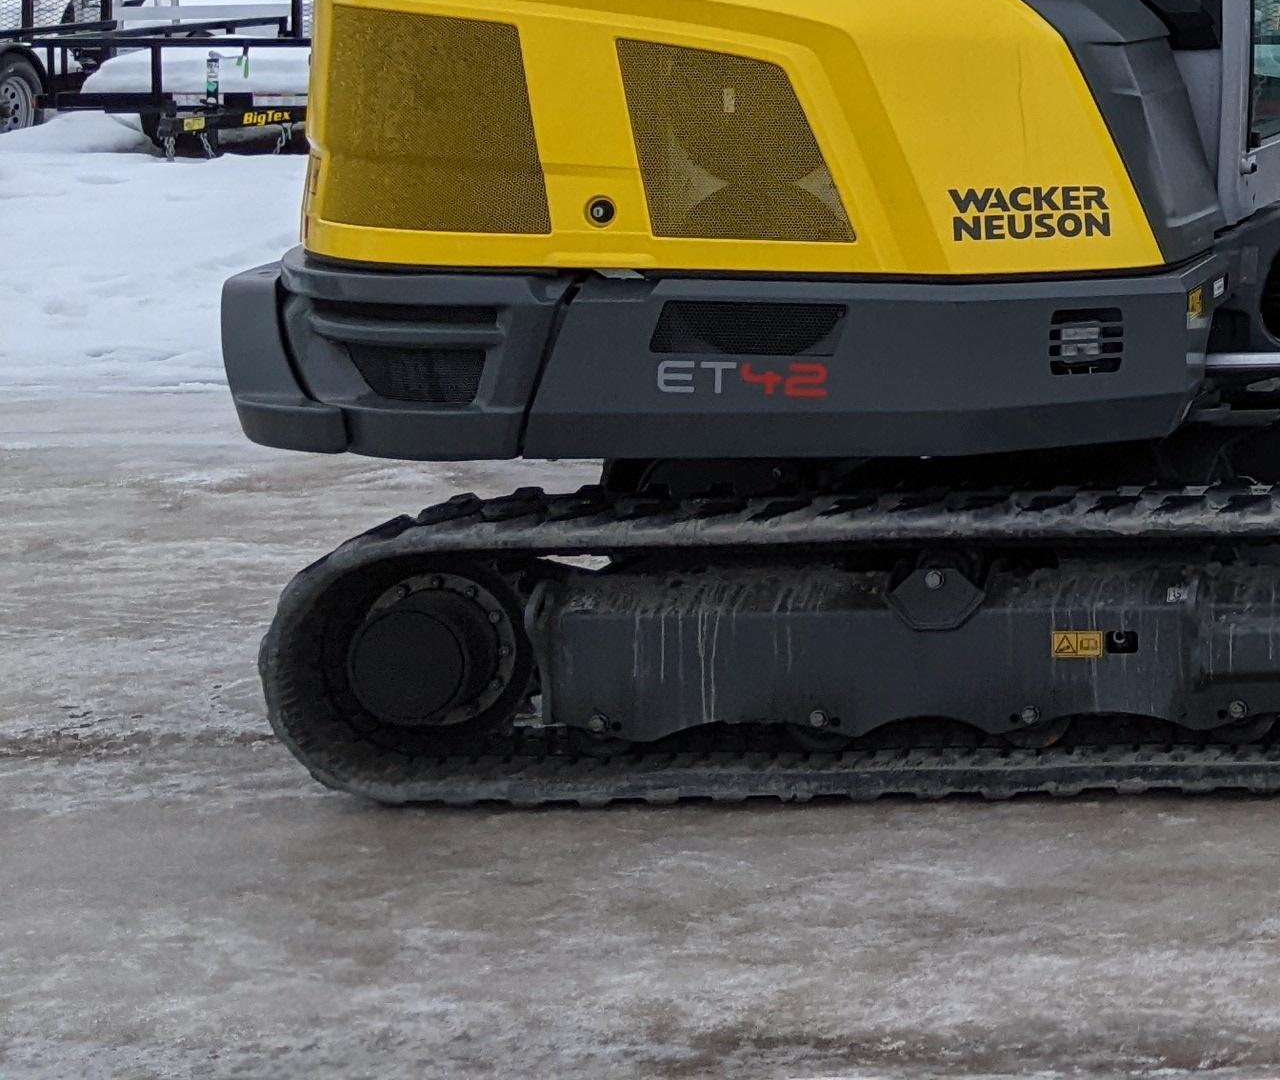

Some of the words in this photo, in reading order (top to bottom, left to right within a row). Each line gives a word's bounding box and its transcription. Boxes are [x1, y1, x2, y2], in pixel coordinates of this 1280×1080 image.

[243, 110, 292, 126] BigTex
[947, 186, 1110, 214] WACKER
[953, 213, 1112, 242] NEUSON
